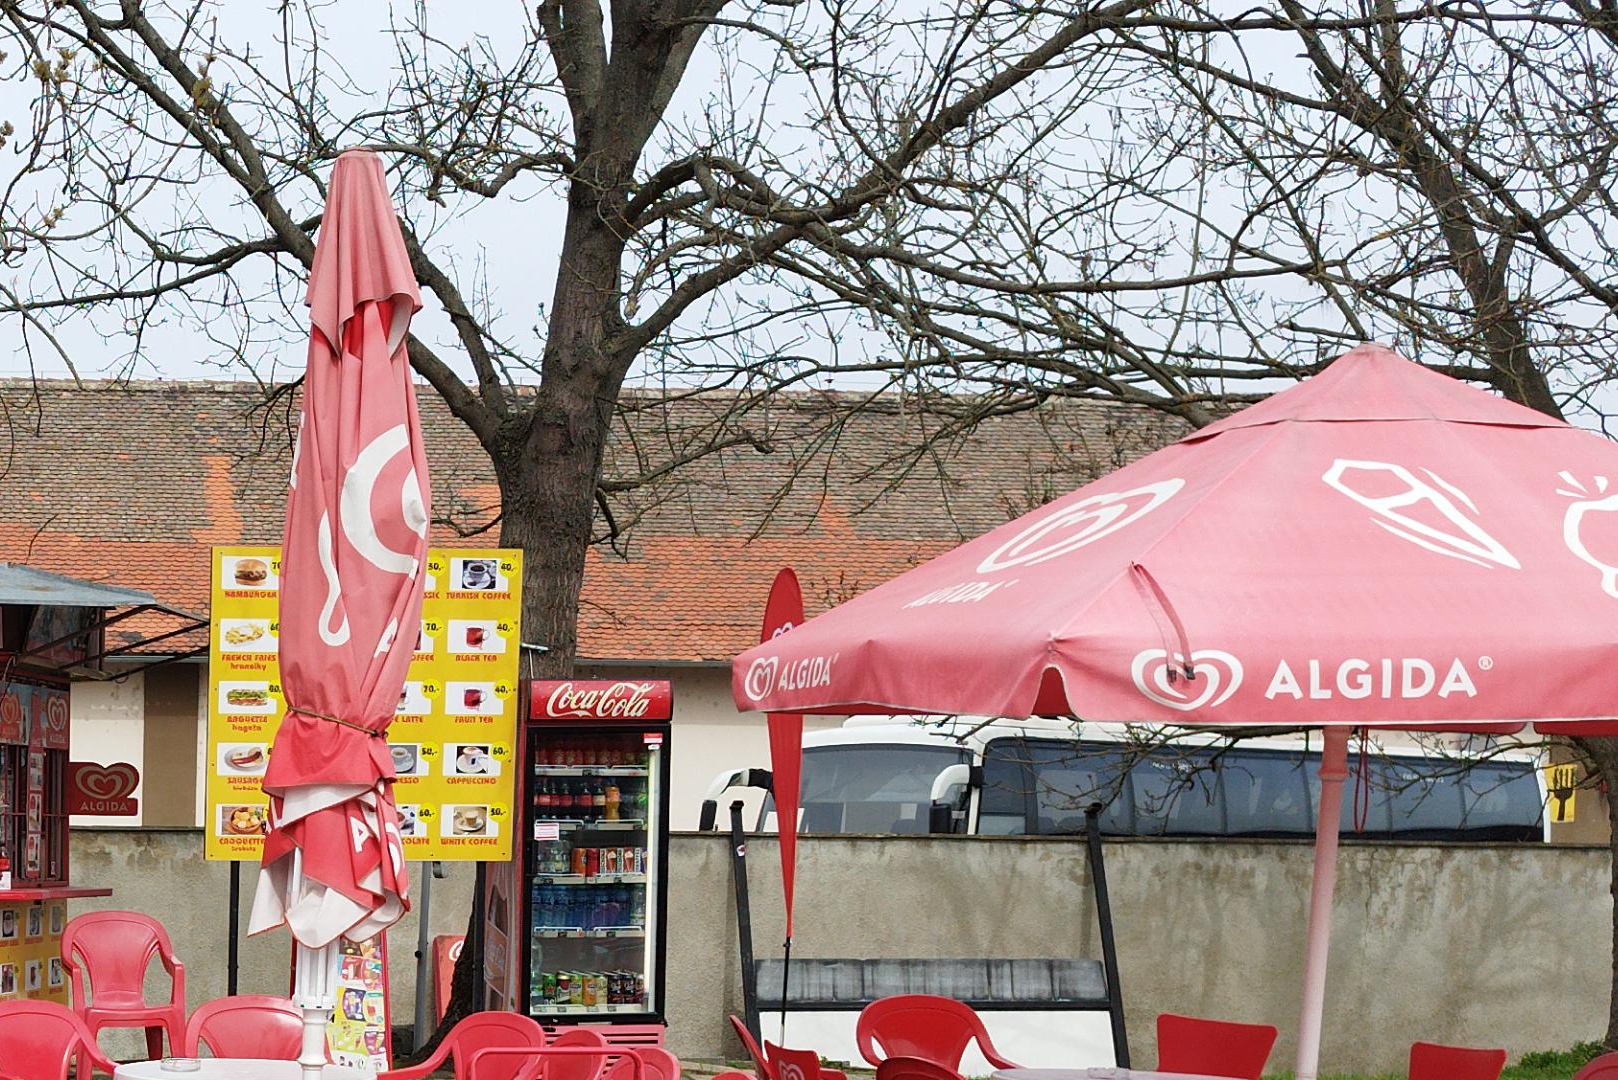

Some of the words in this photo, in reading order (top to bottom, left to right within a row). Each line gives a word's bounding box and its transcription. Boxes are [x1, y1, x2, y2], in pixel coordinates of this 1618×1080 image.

[225, 590, 276, 598] HAMBURGER
[482, 592, 511, 600] COFFEE
[778, 655, 830, 691] ALGIDA
[447, 777, 497, 785] CAPPUCCINO
[80, 802, 128, 812] ALGIDA
[441, 838, 466, 846] WHITE
[468, 838, 498, 846] COFFEE
